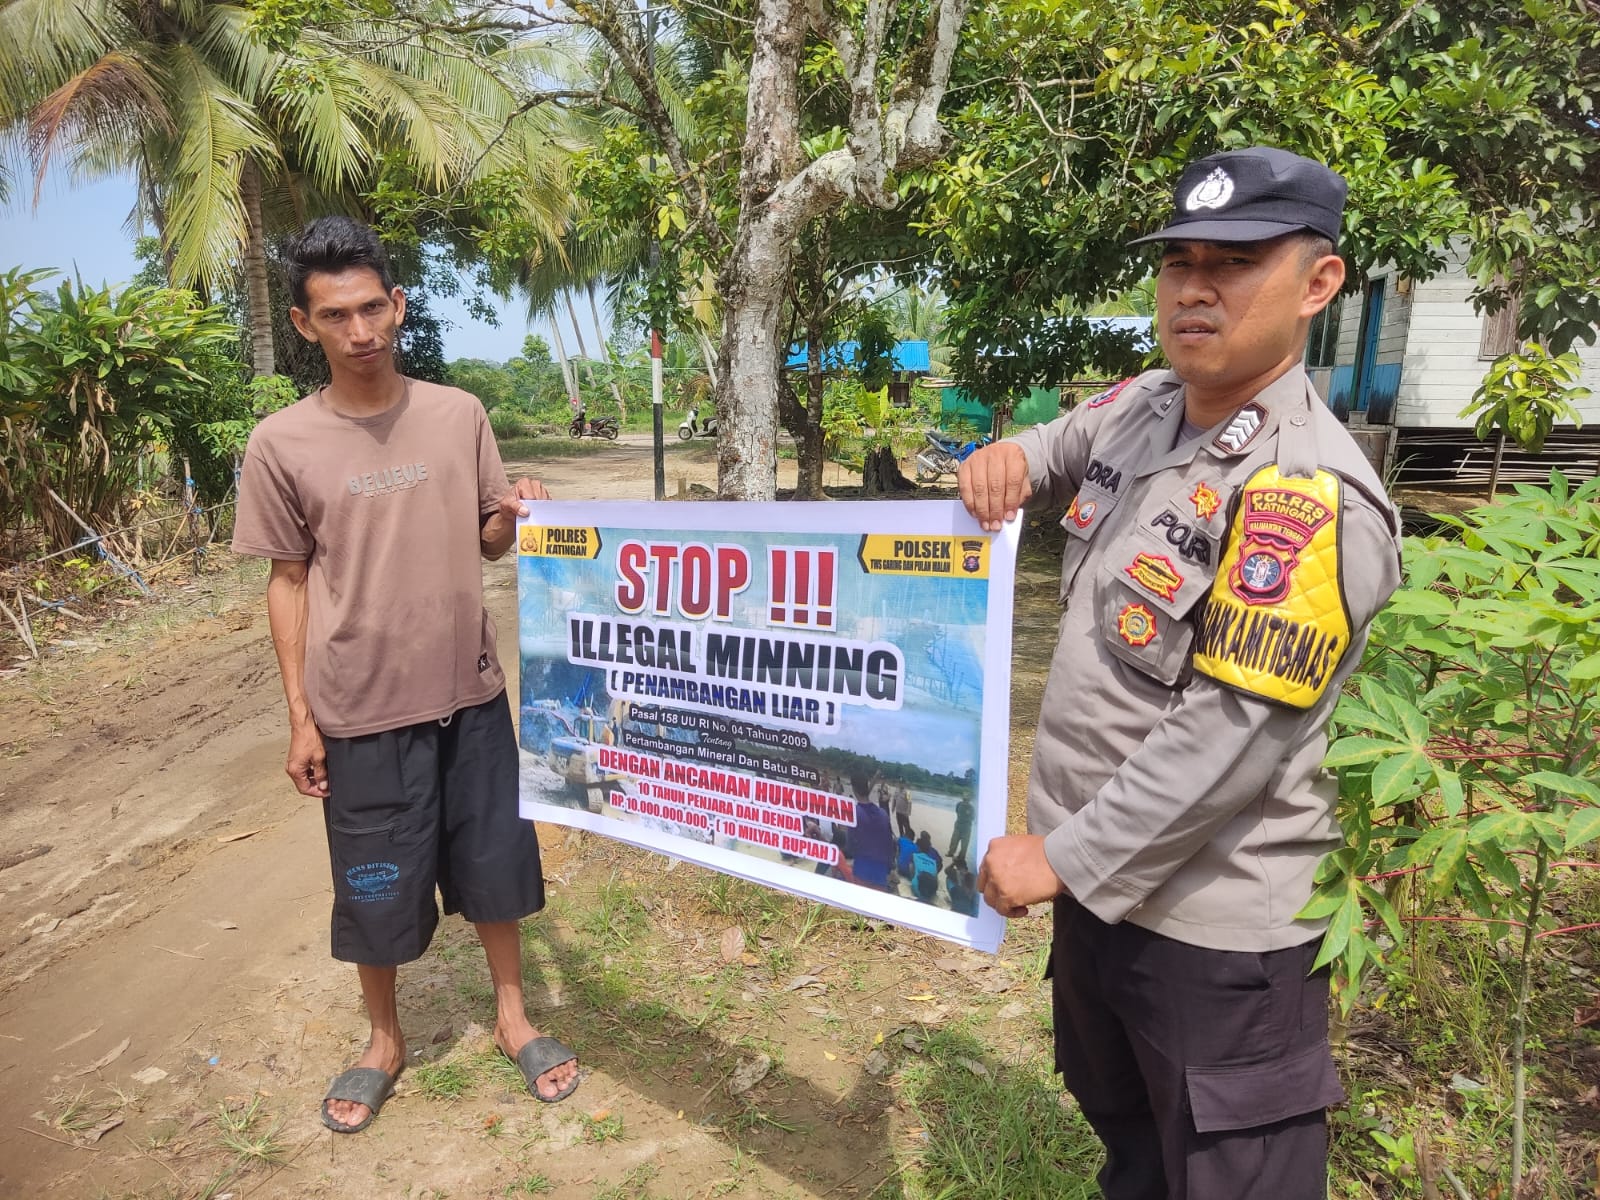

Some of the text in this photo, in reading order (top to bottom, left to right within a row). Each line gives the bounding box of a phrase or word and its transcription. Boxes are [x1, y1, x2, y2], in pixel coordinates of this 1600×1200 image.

[1251, 491, 1325, 520] POLRES
[1253, 502, 1316, 526] KATINGAN
[545, 545, 587, 557] KATINGAN
[546, 528, 588, 545] POLRES
[894, 540, 951, 559] POLSEK
[616, 542, 834, 626] STOP !!!
[570, 618, 898, 703] ILLEGAL MINNING
[622, 671, 766, 715] PENAMBANGAN
[771, 693, 820, 724] LIAR
[631, 707, 808, 748] Pasal 158 UU RI No. 04 Tahun 2009
[701, 732, 733, 749] Tentang
[625, 733, 817, 781] Pertambangan Mineral Dan Batu Bara
[599, 748, 854, 823] DENGAN ANCAMAN HUKUMAN
[638, 781, 802, 833] 10 TAHUN PENJARA DAN DENDA
[611, 793, 626, 808] RP.
[723, 821, 736, 837] 10
[738, 824, 779, 848] MILYAR
[782, 835, 829, 861] RUPIAH
